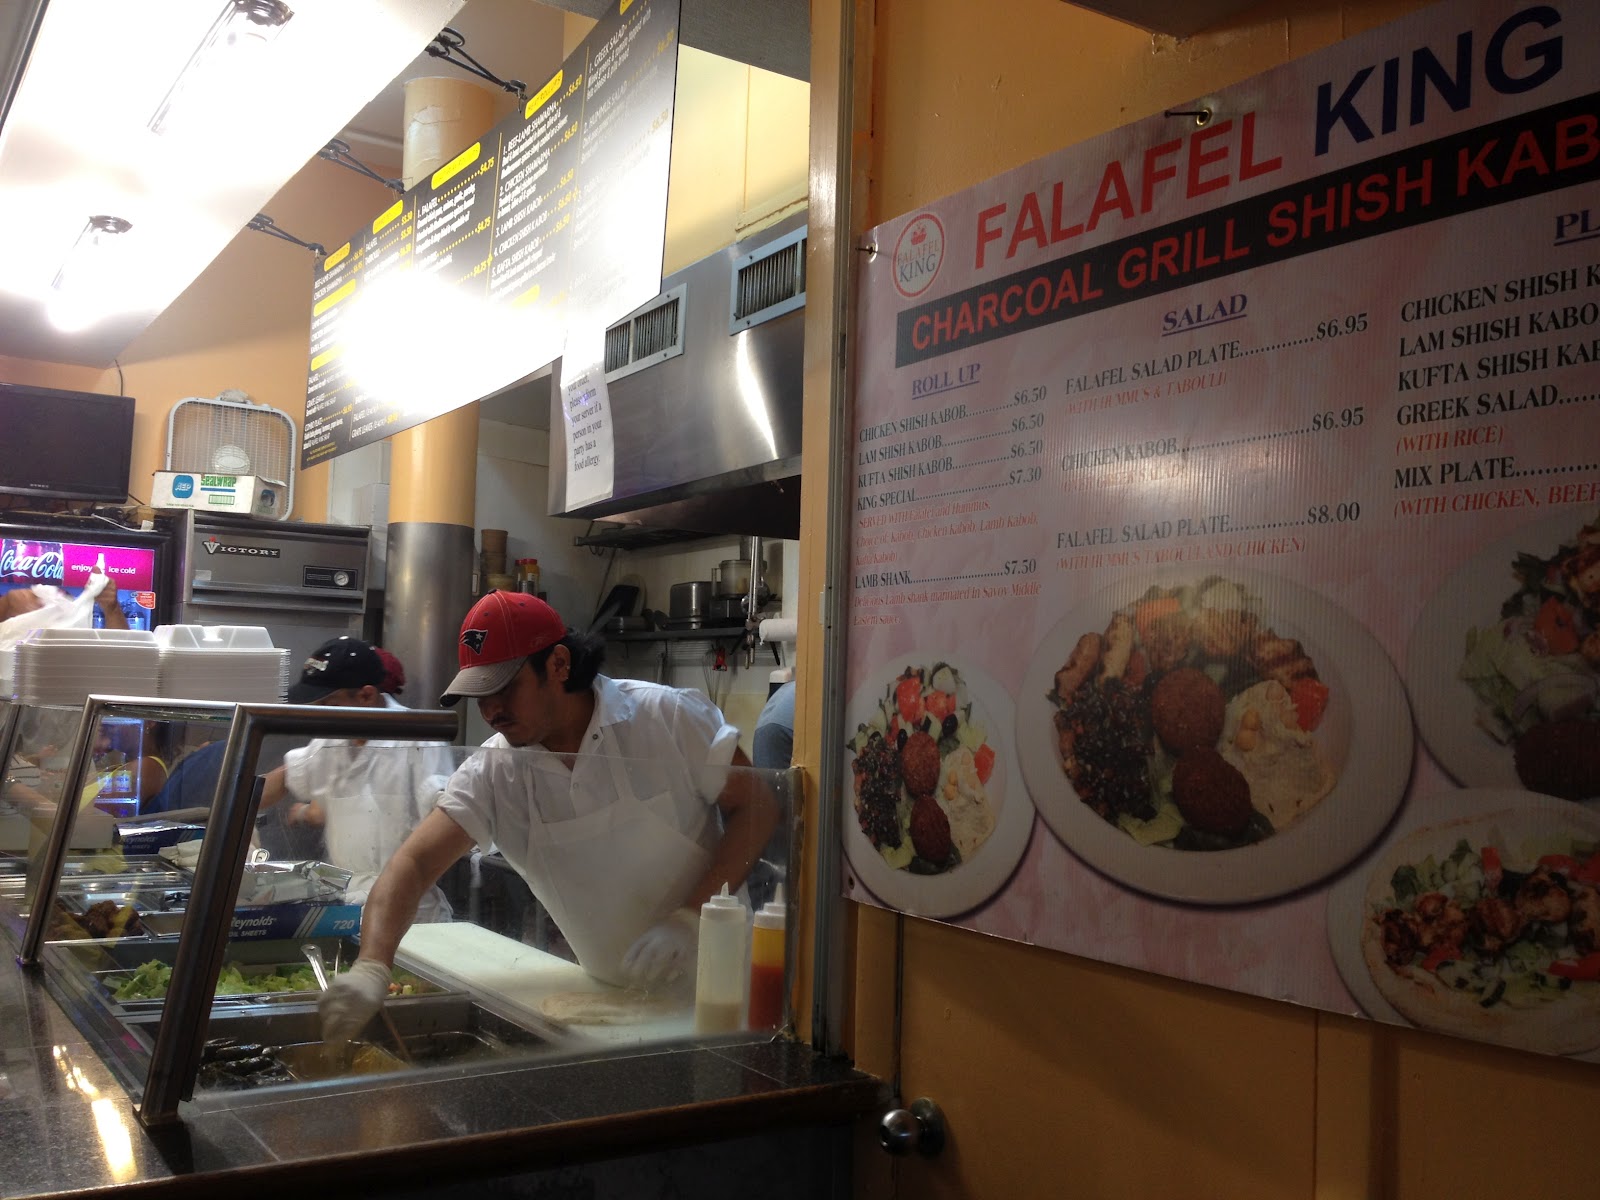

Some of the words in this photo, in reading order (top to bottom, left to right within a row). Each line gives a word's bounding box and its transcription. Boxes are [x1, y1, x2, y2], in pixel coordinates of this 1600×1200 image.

[974, 111, 1282, 270] FALAFEL
[1314, 5, 1563, 157] KING
[899, 253, 936, 282] KING
[912, 263, 1104, 350] CHARCOAL
[1117, 218, 1249, 289] GRILL
[1266, 158, 1433, 247] SHISH
[1401, 284, 1498, 323] CHICKEN
[1504, 268, 1577, 303] SHISH
[1162, 293, 1248, 333] SALAD
[1400, 329, 1445, 358] LAM
[1451, 316, 1520, 348] SHISH
[1065, 365, 1127, 395] FALAFEL
[1131, 353, 1183, 381] SALAD
[1316, 312, 1368, 340] $6.95
[912, 372, 953, 396] ROLL
[958, 363, 980, 384] UP
[1398, 361, 1470, 392] KUFTA
[1476, 347, 1548, 380] SHISH
[1397, 396, 1470, 426] GREEK
[573, 427, 586, 443] person
[592, 420, 602, 433] your
[859, 421, 897, 443] CHICKEN
[899, 413, 929, 434] SHISH
[1062, 446, 1119, 472] CHICKEN
[1312, 406, 1364, 432] $6.95
[1396, 431, 1449, 456] (WITH
[1453, 425, 1504, 448] RICE)
[574, 457, 584, 472] food
[858, 450, 877, 466] LAM
[878, 440, 906, 462] SHISH
[858, 471, 886, 489] KUFTA
[888, 463, 916, 483] SHISH
[1394, 465, 1432, 489] MIX
[857, 495, 877, 511] KING
[1394, 495, 1447, 519] (WITH
[1057, 528, 1118, 549] FALAFEL
[1121, 521, 1172, 543] SALAD
[1307, 501, 1360, 525] $8.00
[204, 541, 278, 556] VICTORY
[0, 549, 63, 578] Coca-Cola
[71, 563, 93, 572] enjoy
[108, 566, 119, 574] ice
[120, 566, 136, 575] cold
[855, 573, 878, 589] LAMB
[240, 929, 267, 937] SHEETS
[332, 919, 355, 930] 720
